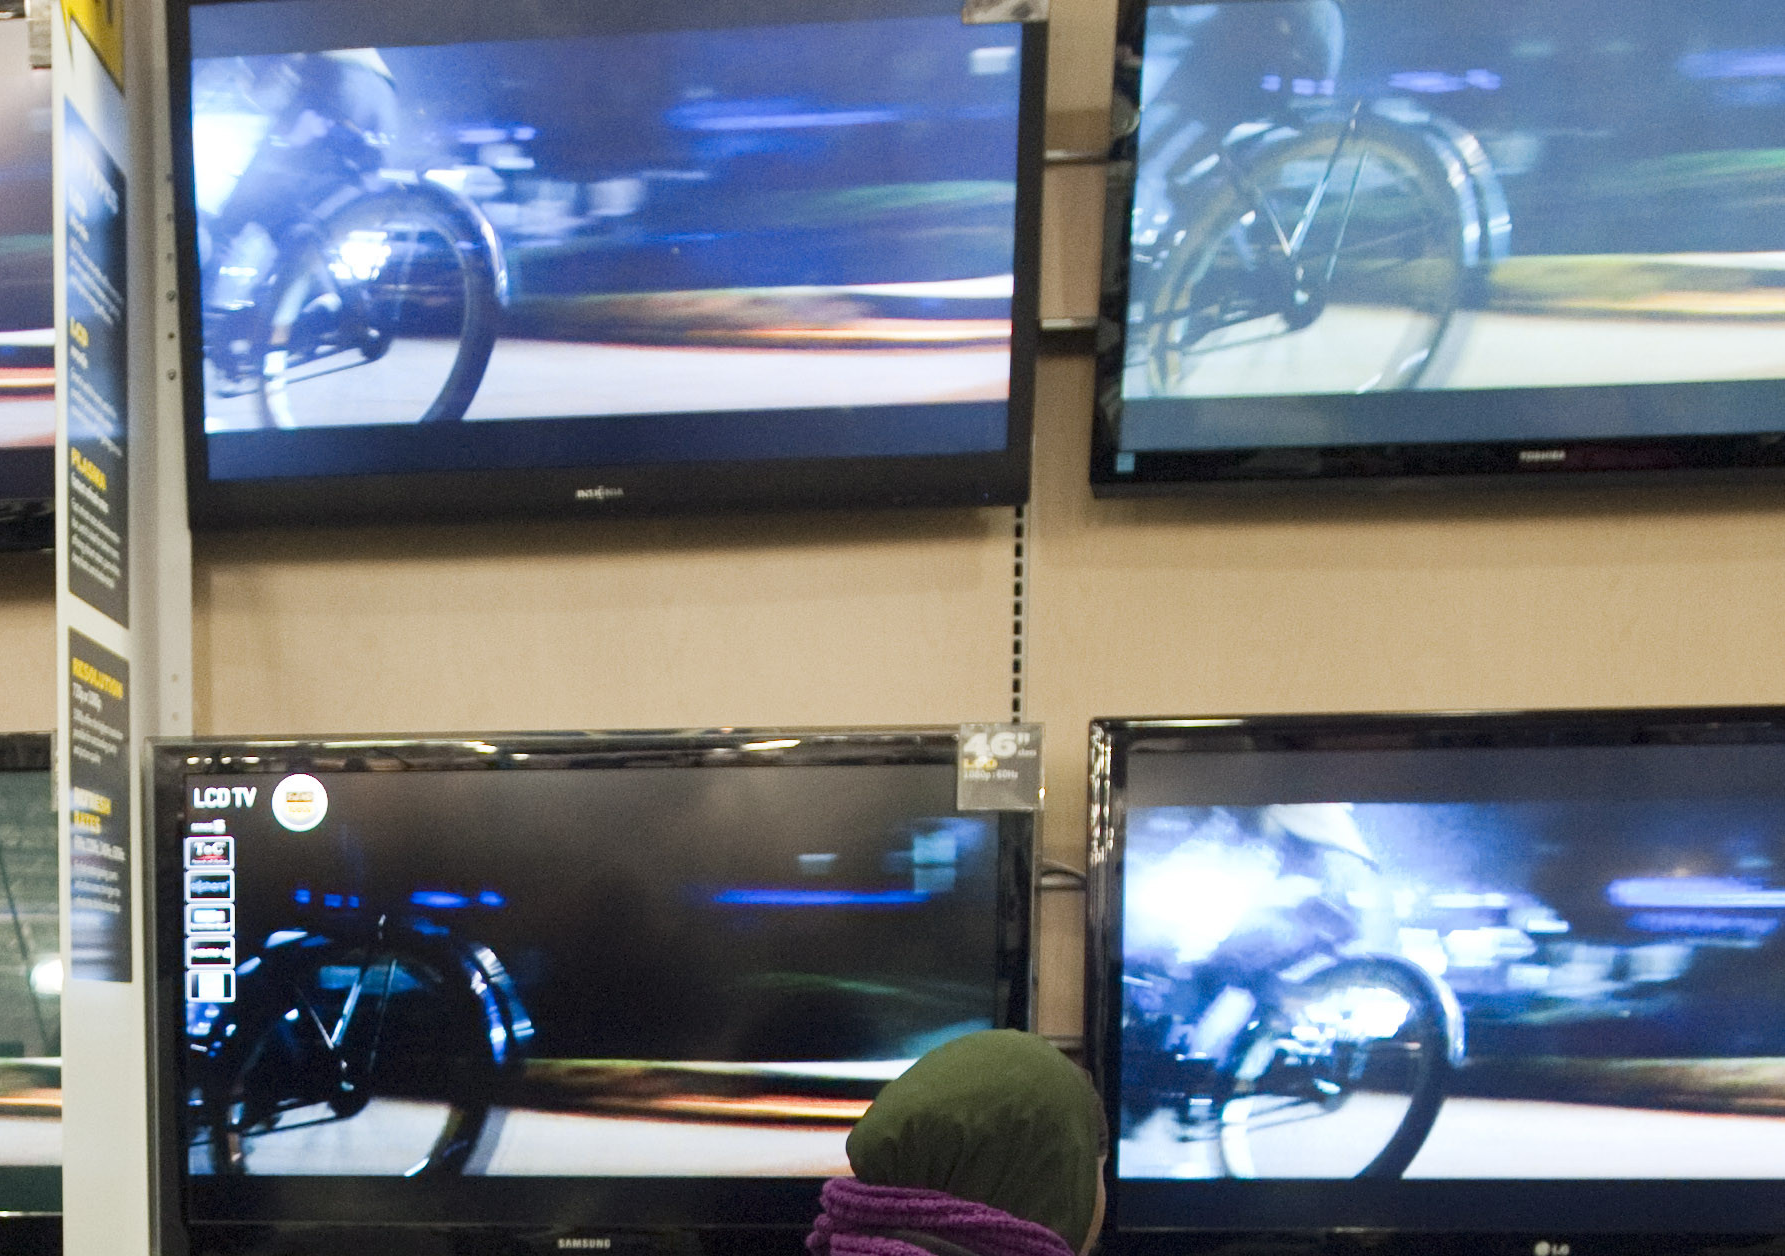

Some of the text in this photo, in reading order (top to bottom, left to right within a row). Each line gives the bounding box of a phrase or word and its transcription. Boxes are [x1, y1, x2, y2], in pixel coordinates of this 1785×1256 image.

[71, 447, 107, 491] PLASMA
[72, 657, 124, 700] RESOLUTION
[193, 786, 257, 809] LCD TV
[558, 1238, 611, 1250] SAMSUNG
